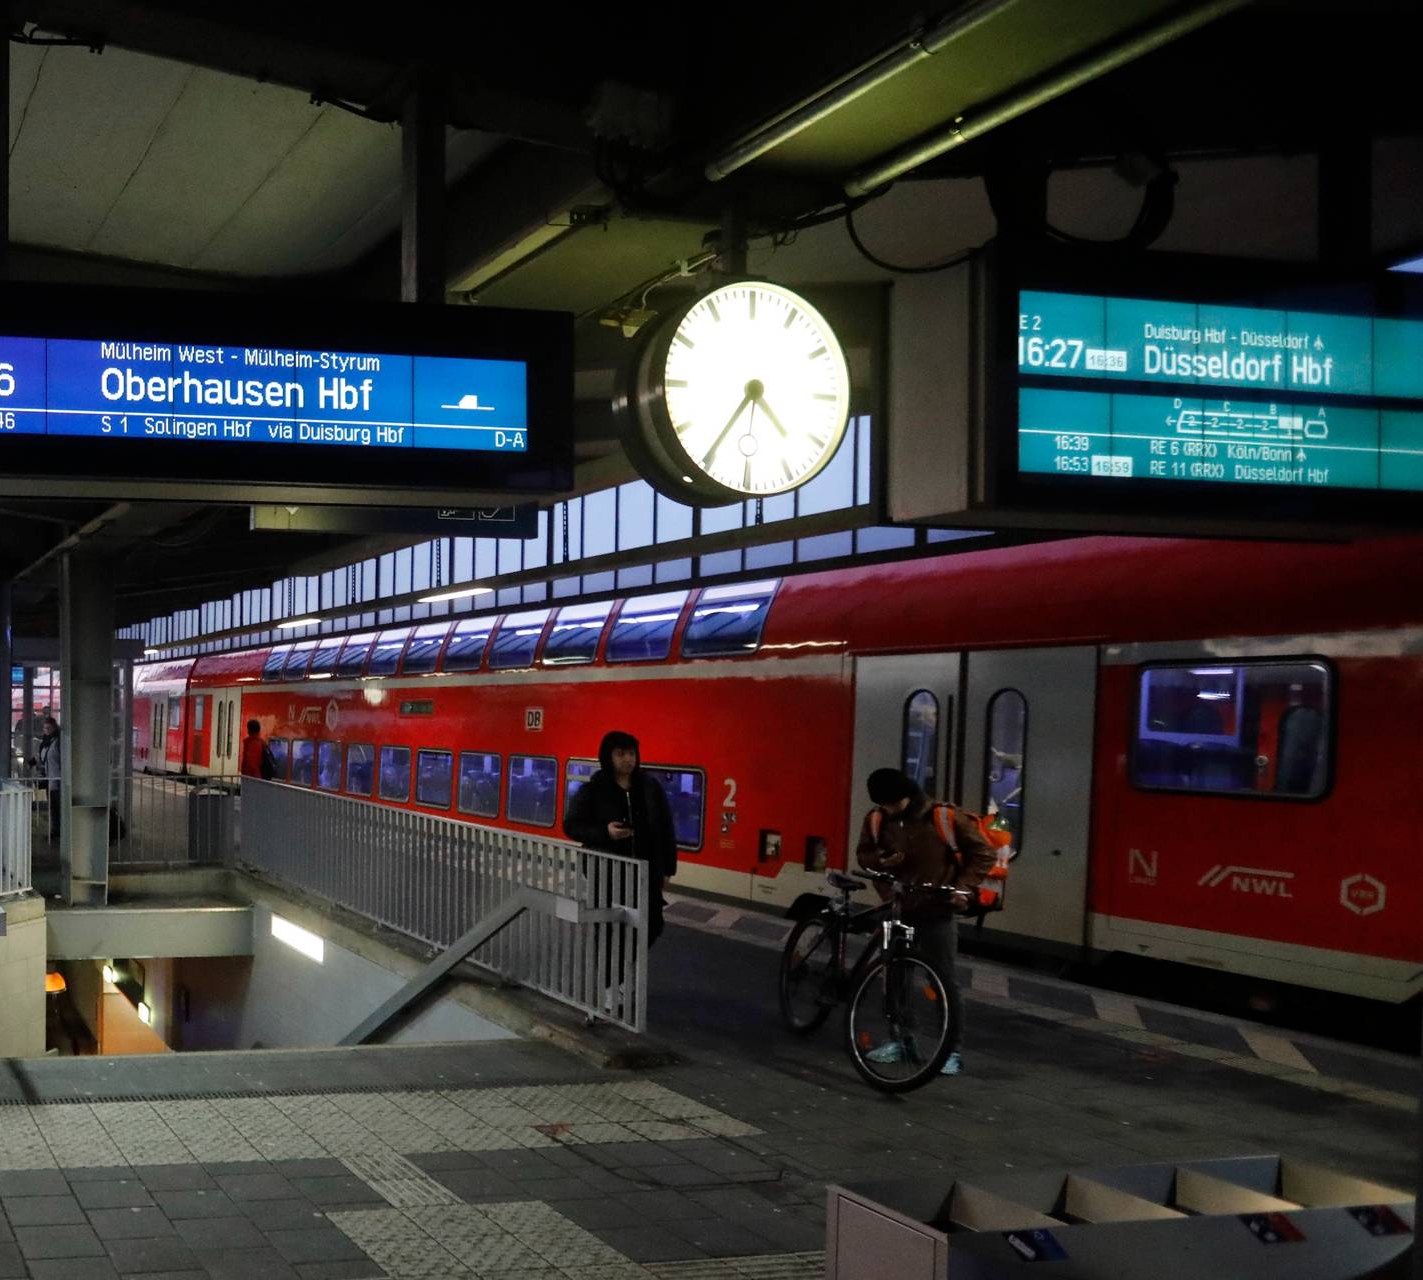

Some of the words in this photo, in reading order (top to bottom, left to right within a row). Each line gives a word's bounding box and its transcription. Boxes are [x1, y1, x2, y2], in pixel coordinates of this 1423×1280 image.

[1032, 315, 1042, 330] 2
[1144, 323, 1201, 344] Duisburg
[1204, 328, 1226, 344] Hbf
[1241, 330, 1310, 350] Düsseldorf
[101, 342, 171, 362] Mülheim
[179, 346, 225, 364] West
[244, 348, 380, 372] Mülheim-Styrum
[1018, 336, 1084, 369] 16:27
[1144, 345, 1283, 383] Düsseldorf
[1292, 354, 1333, 386] Hbf
[101, 367, 304, 408] Oberhausen
[319, 377, 373, 411] Hbf
[1223, 402, 1230, 413] C
[1270, 404, 1277, 415] B
[1318, 407, 1326, 418] A
[102, 416, 112, 432] S
[120, 416, 128, 433] 1
[145, 417, 217, 439] Solingen
[224, 420, 251, 437] Hbf
[268, 423, 293, 439] via
[299, 423, 371, 445] Duisburg
[377, 426, 405, 443] Hbf
[495, 431, 525, 448] D-A
[1054, 435, 1090, 451] 16:39
[1150, 440, 1167, 455] RE
[1170, 441, 1179, 456] 6
[1183, 442, 1218, 458] (RRX)
[1227, 443, 1293, 462] Köln/Bonn
[1054, 455, 1089, 472] 16:53
[1095, 460, 1130, 474] 16:59
[1150, 461, 1167, 476] RE
[1171, 462, 1186, 477] 11
[1190, 463, 1225, 479] (RRX)
[1235, 464, 1304, 482] Düsseldorf
[1307, 468, 1329, 484] Hbf
[527, 709, 542, 727] DB
[723, 778, 737, 807] 2
[1129, 848, 1157, 877] N
[1232, 876, 1294, 898] NWL
